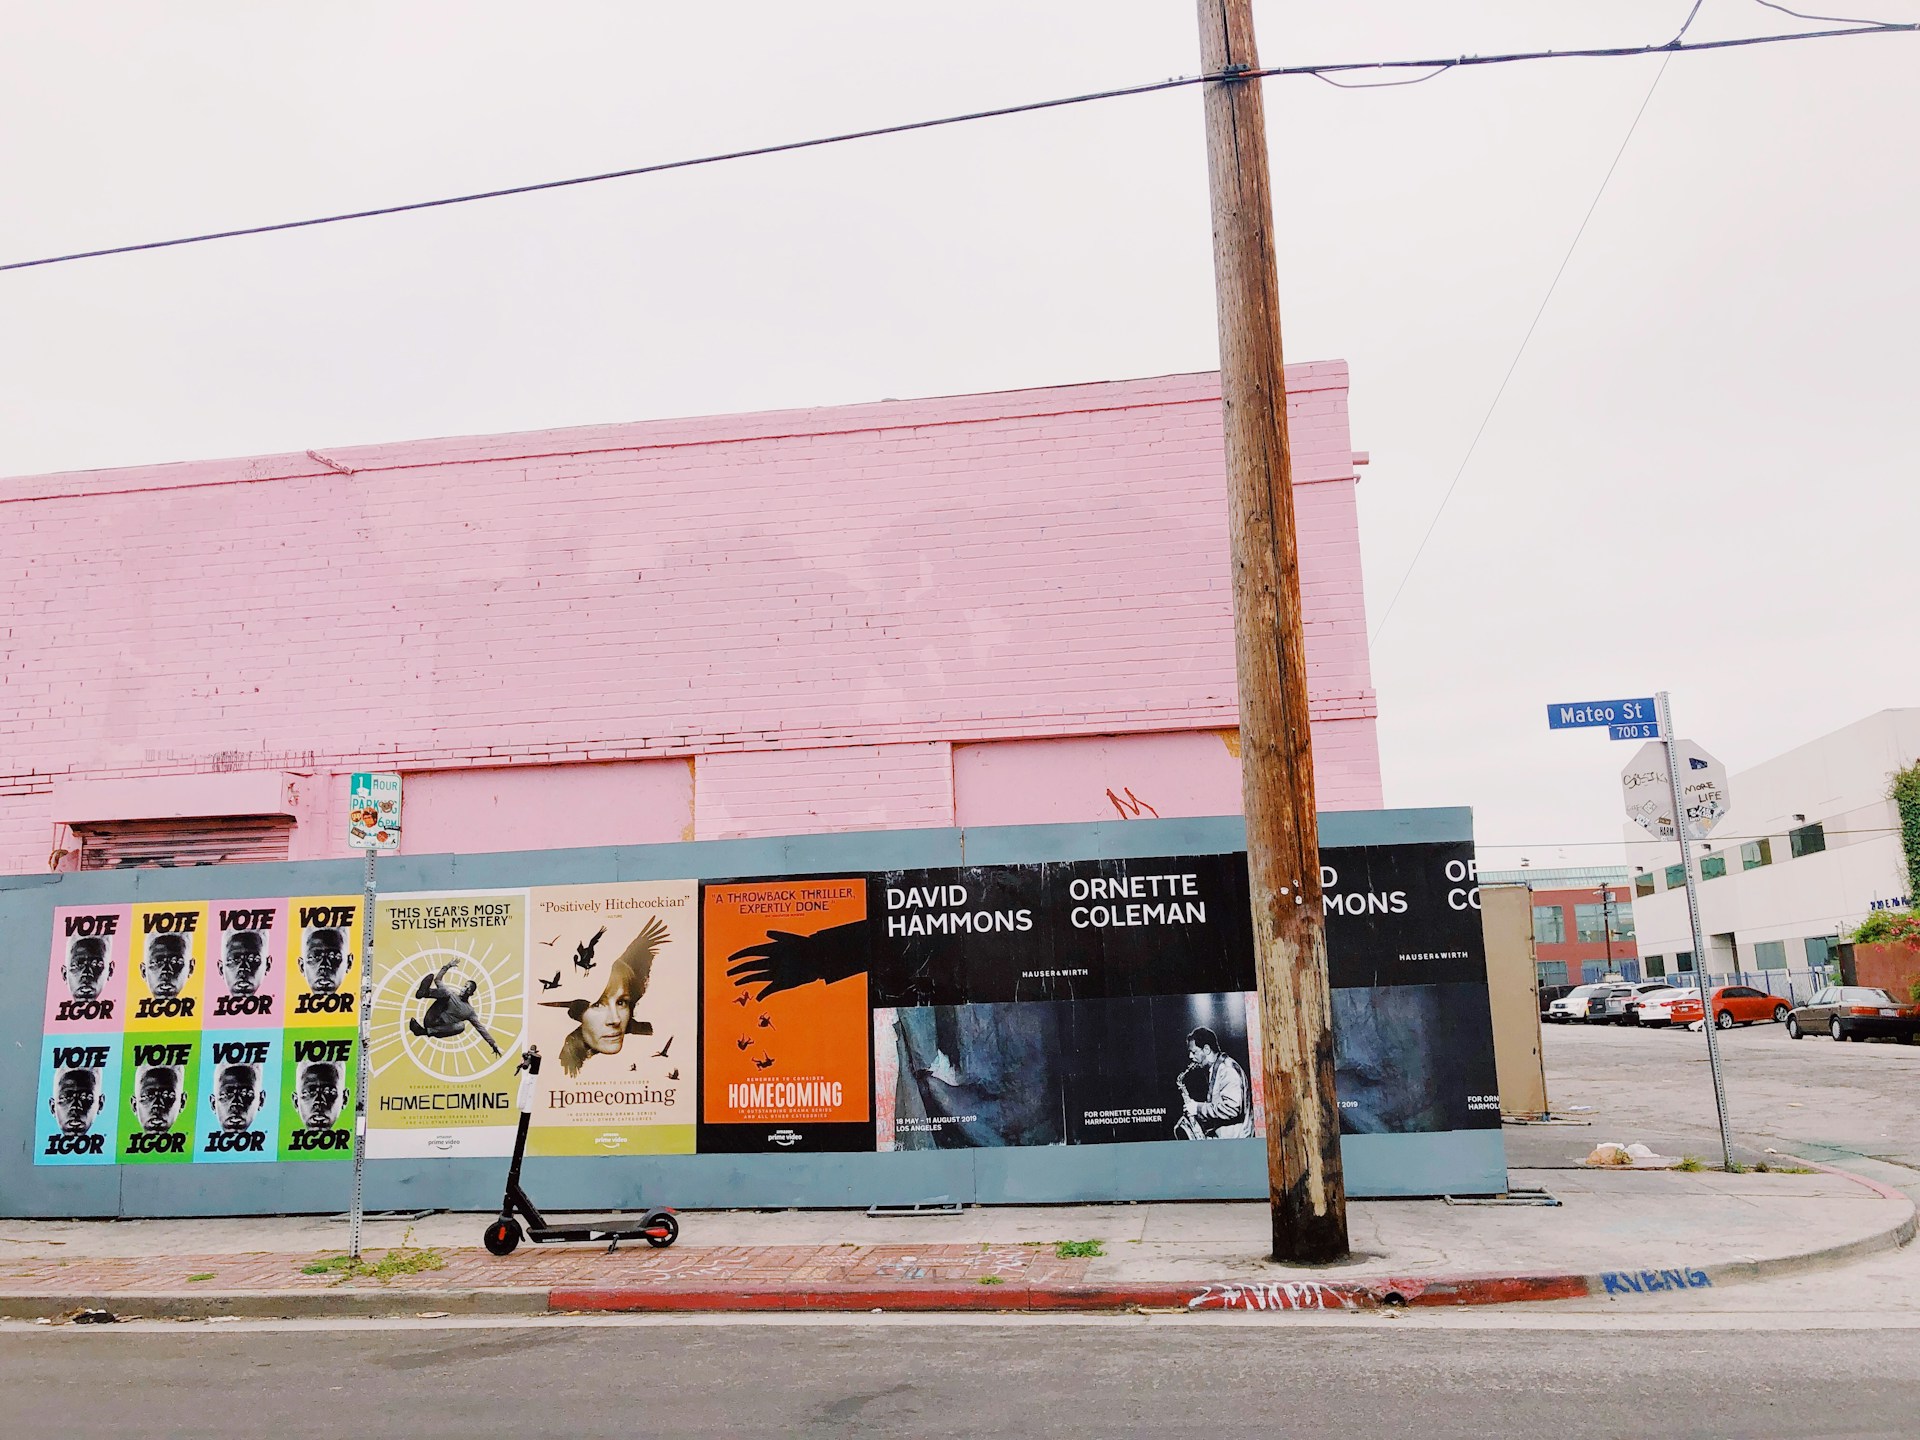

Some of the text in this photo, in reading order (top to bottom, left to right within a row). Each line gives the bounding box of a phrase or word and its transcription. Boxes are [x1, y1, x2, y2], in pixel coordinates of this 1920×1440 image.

[1561, 702, 1642, 724] Mateo St
[1617, 725, 1650, 738] 700 S
[1685, 781, 1715, 795] MORE
[1698, 791, 1722, 803] LIFE
[1660, 826, 1673, 836] HARM
[728, 891, 796, 903] THROWBACK
[887, 884, 968, 910] DAVID
[1069, 873, 1199, 901] ORNETTE
[426, 905, 469, 917] YEAR'S
[474, 904, 511, 915] MOST
[740, 902, 791, 914] EXPERTLY
[1323, 891, 1408, 916] MONS
[64, 914, 120, 937] VOTE
[143, 911, 199, 934] VOTE
[219, 908, 276, 931] VOTE
[299, 906, 356, 928] VOTE
[391, 918, 445, 930] STYLISH
[887, 909, 1033, 938] HAMMONS
[1071, 901, 1206, 929] COLEMAN
[55, 1000, 114, 1020] IGOR
[135, 997, 195, 1019] IGOR
[213, 995, 272, 1016] IGOR
[294, 993, 354, 1013] IGOR
[52, 1046, 111, 1068] VOTE
[133, 1044, 192, 1066] VOTE
[212, 1042, 270, 1064] VOTE
[294, 1040, 353, 1062] VOTE
[380, 1092, 509, 1111] HOMECOMING
[548, 1085, 676, 1108] Homecoming
[728, 1081, 843, 1108] HOMECOMING
[1085, 1117, 1130, 1125] HARMOLODIC
[45, 1134, 105, 1155] IGOR
[126, 1132, 187, 1153] IGOR
[204, 1131, 265, 1152] IGOR
[288, 1129, 350, 1150] IGOR
